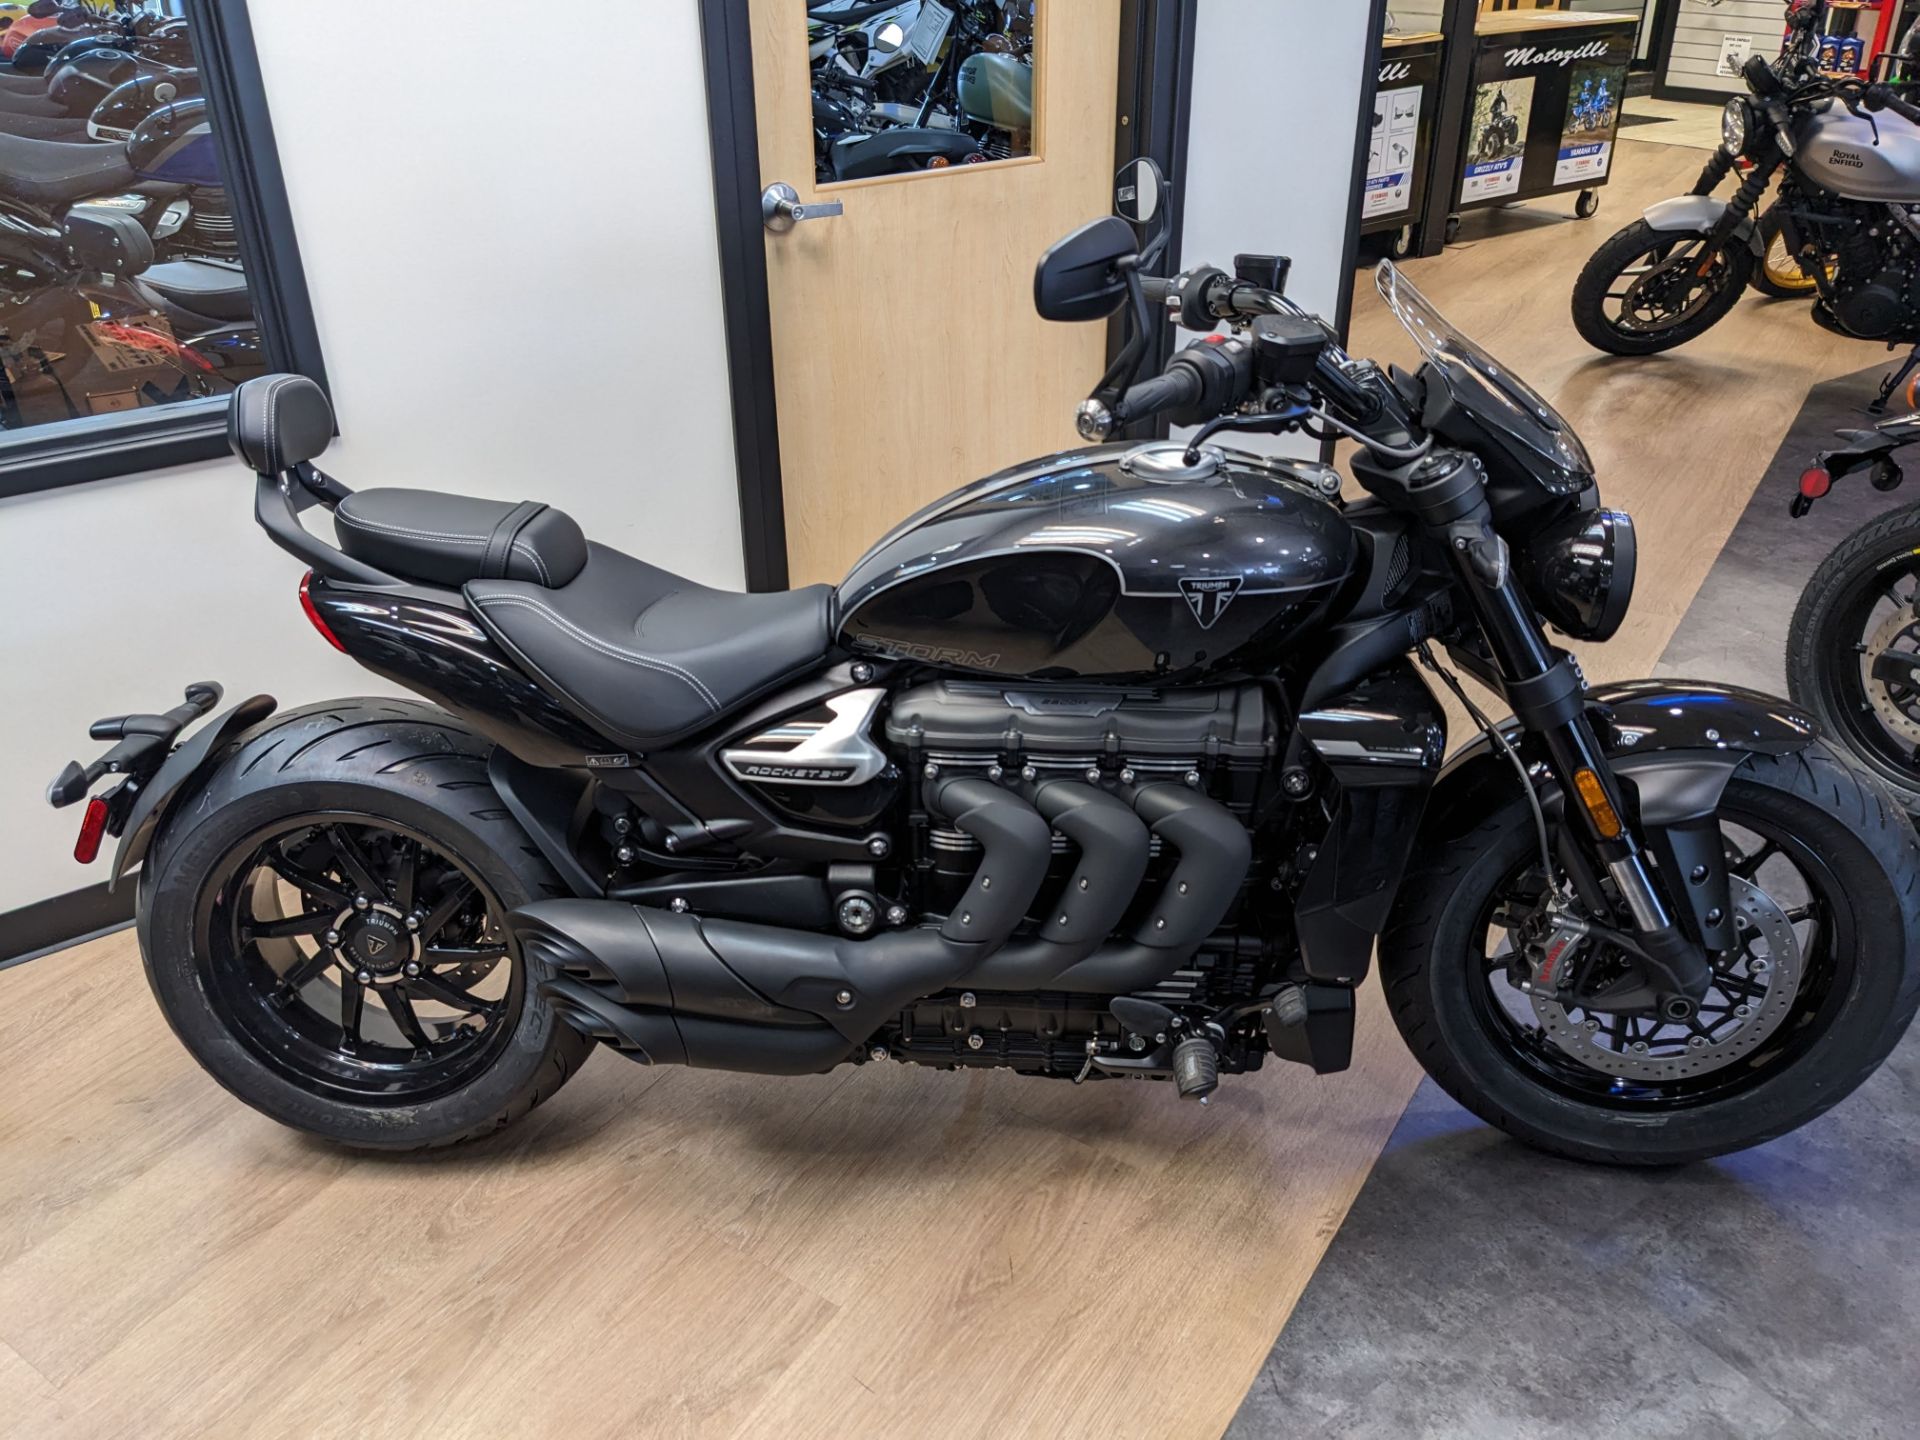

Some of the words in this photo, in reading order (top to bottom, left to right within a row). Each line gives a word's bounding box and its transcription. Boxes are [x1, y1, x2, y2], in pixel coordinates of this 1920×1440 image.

[1504, 41, 1609, 67] Motozilli
[1828, 156, 1864, 168] ENFIELD
[1833, 149, 1861, 160] ROYAL
[1191, 581, 1230, 590] TRIUMPH
[851, 632, 1001, 669] STORM
[366, 918, 399, 936] TRIUMPH
